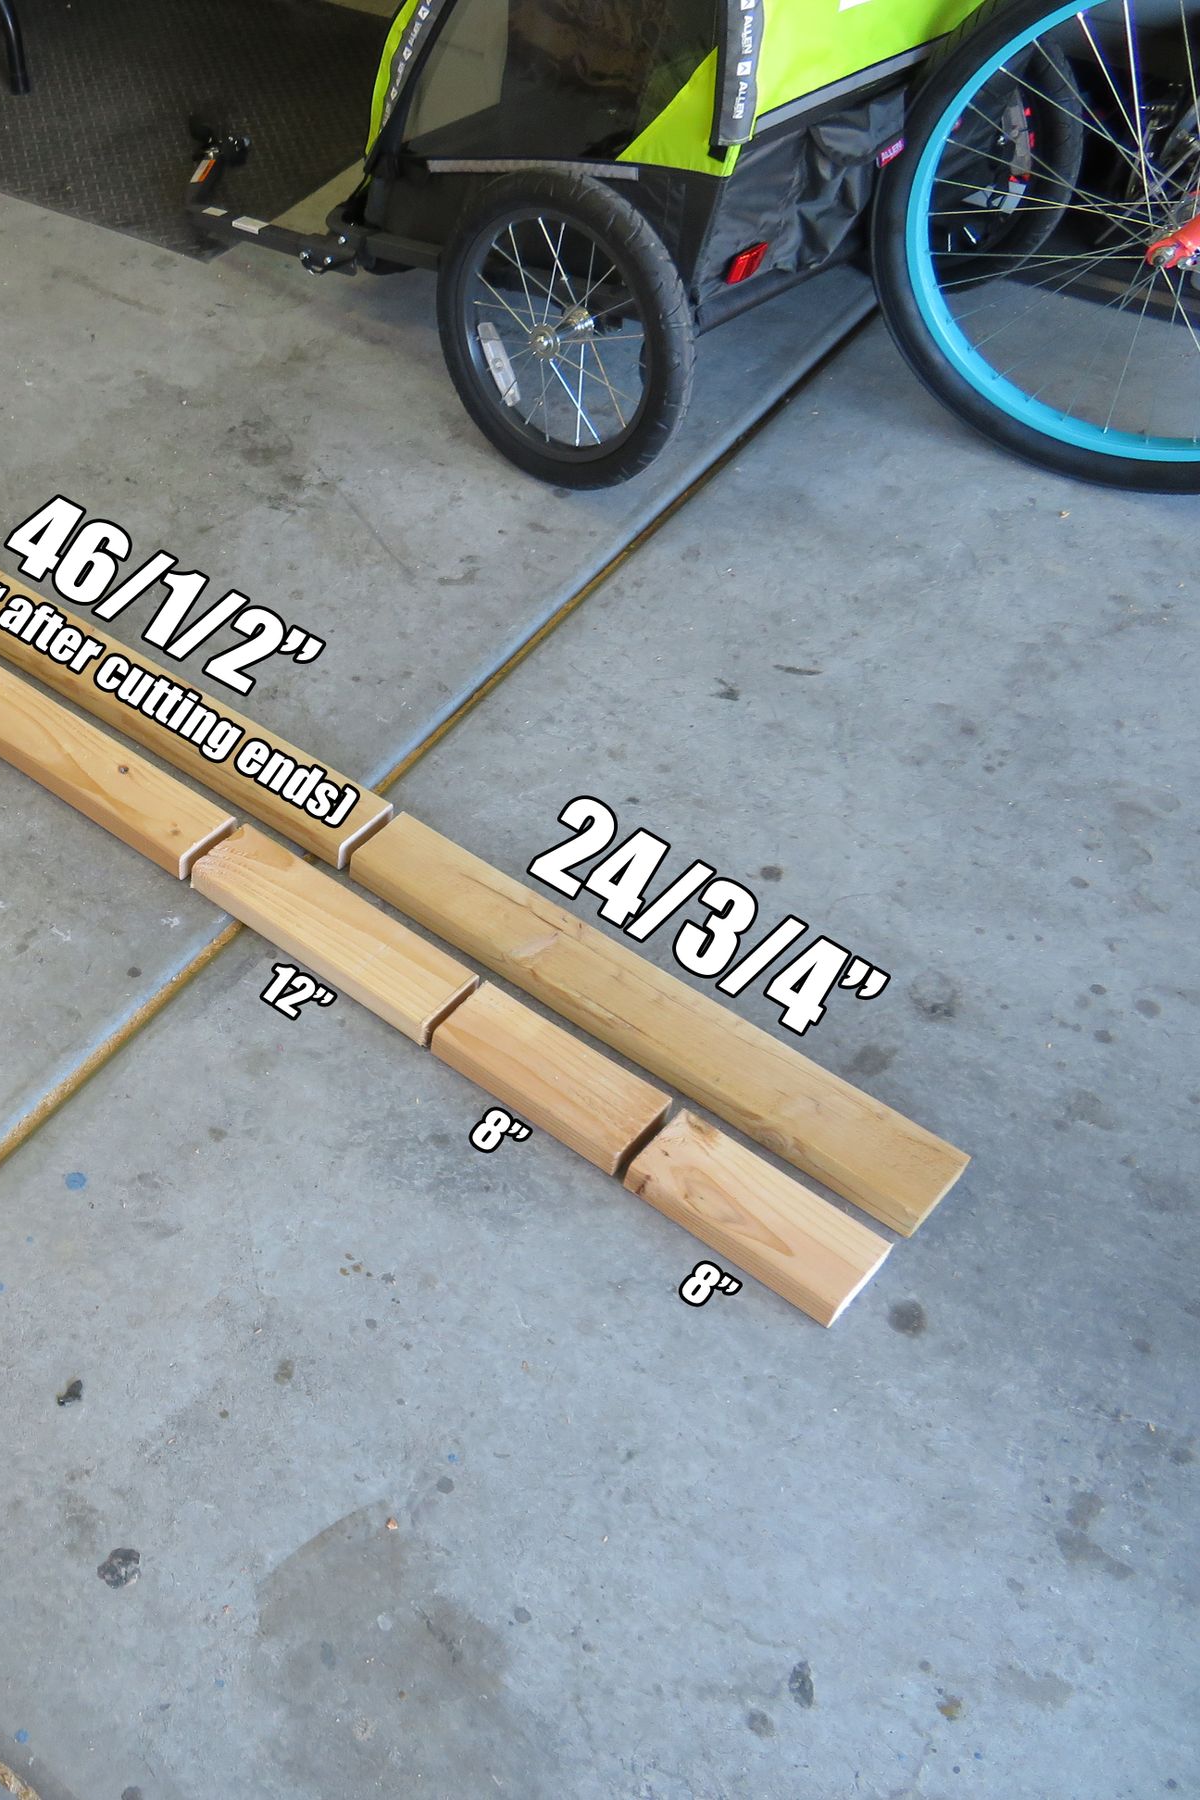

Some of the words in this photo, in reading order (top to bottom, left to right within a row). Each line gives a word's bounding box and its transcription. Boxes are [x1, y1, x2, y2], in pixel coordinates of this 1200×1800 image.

[742, 14, 754, 55] ALLEN
[733, 80, 749, 120] ALLEN
[881, 139, 904, 161] ALLEN
